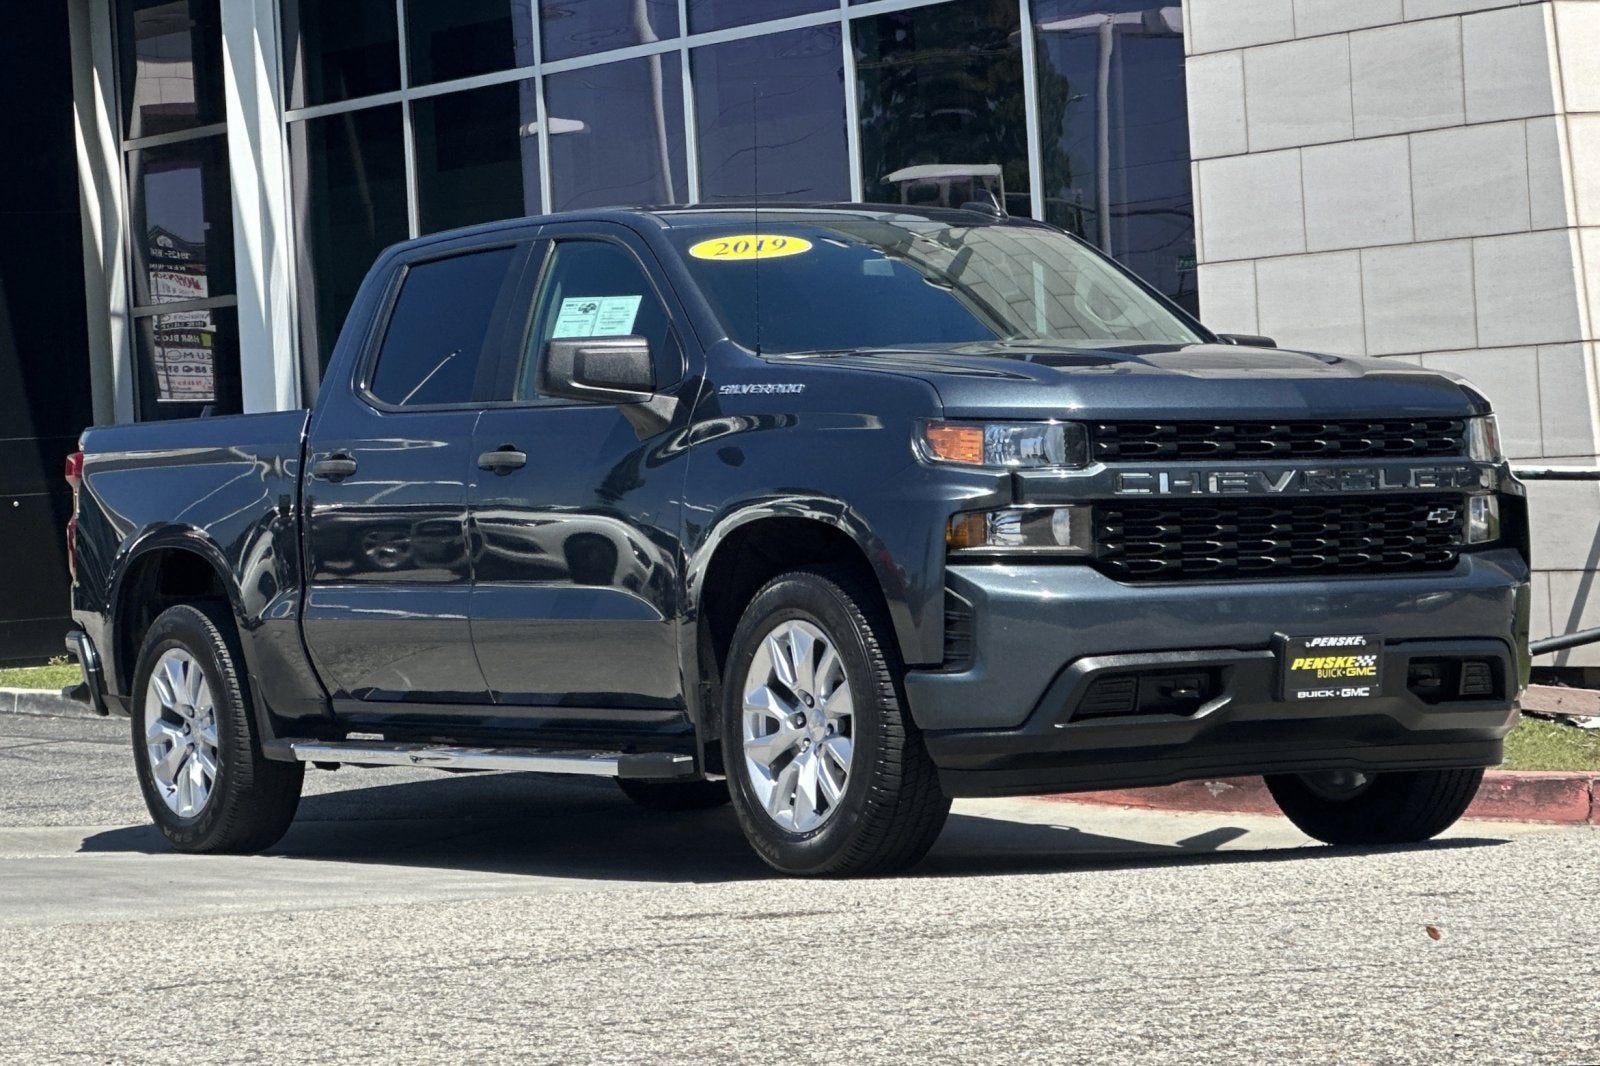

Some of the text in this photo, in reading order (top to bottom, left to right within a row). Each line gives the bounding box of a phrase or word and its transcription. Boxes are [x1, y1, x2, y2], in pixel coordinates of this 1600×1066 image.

[713, 238, 788, 256] 2019
[718, 383, 806, 395] SILVERADO
[1114, 466, 1471, 495] CHEVROLET
[1311, 636, 1363, 647] PENSKE
[1291, 656, 1357, 670] PENSKE
[1317, 667, 1376, 678] BUICK GMC
[1297, 687, 1370, 698] BUICK GMC
